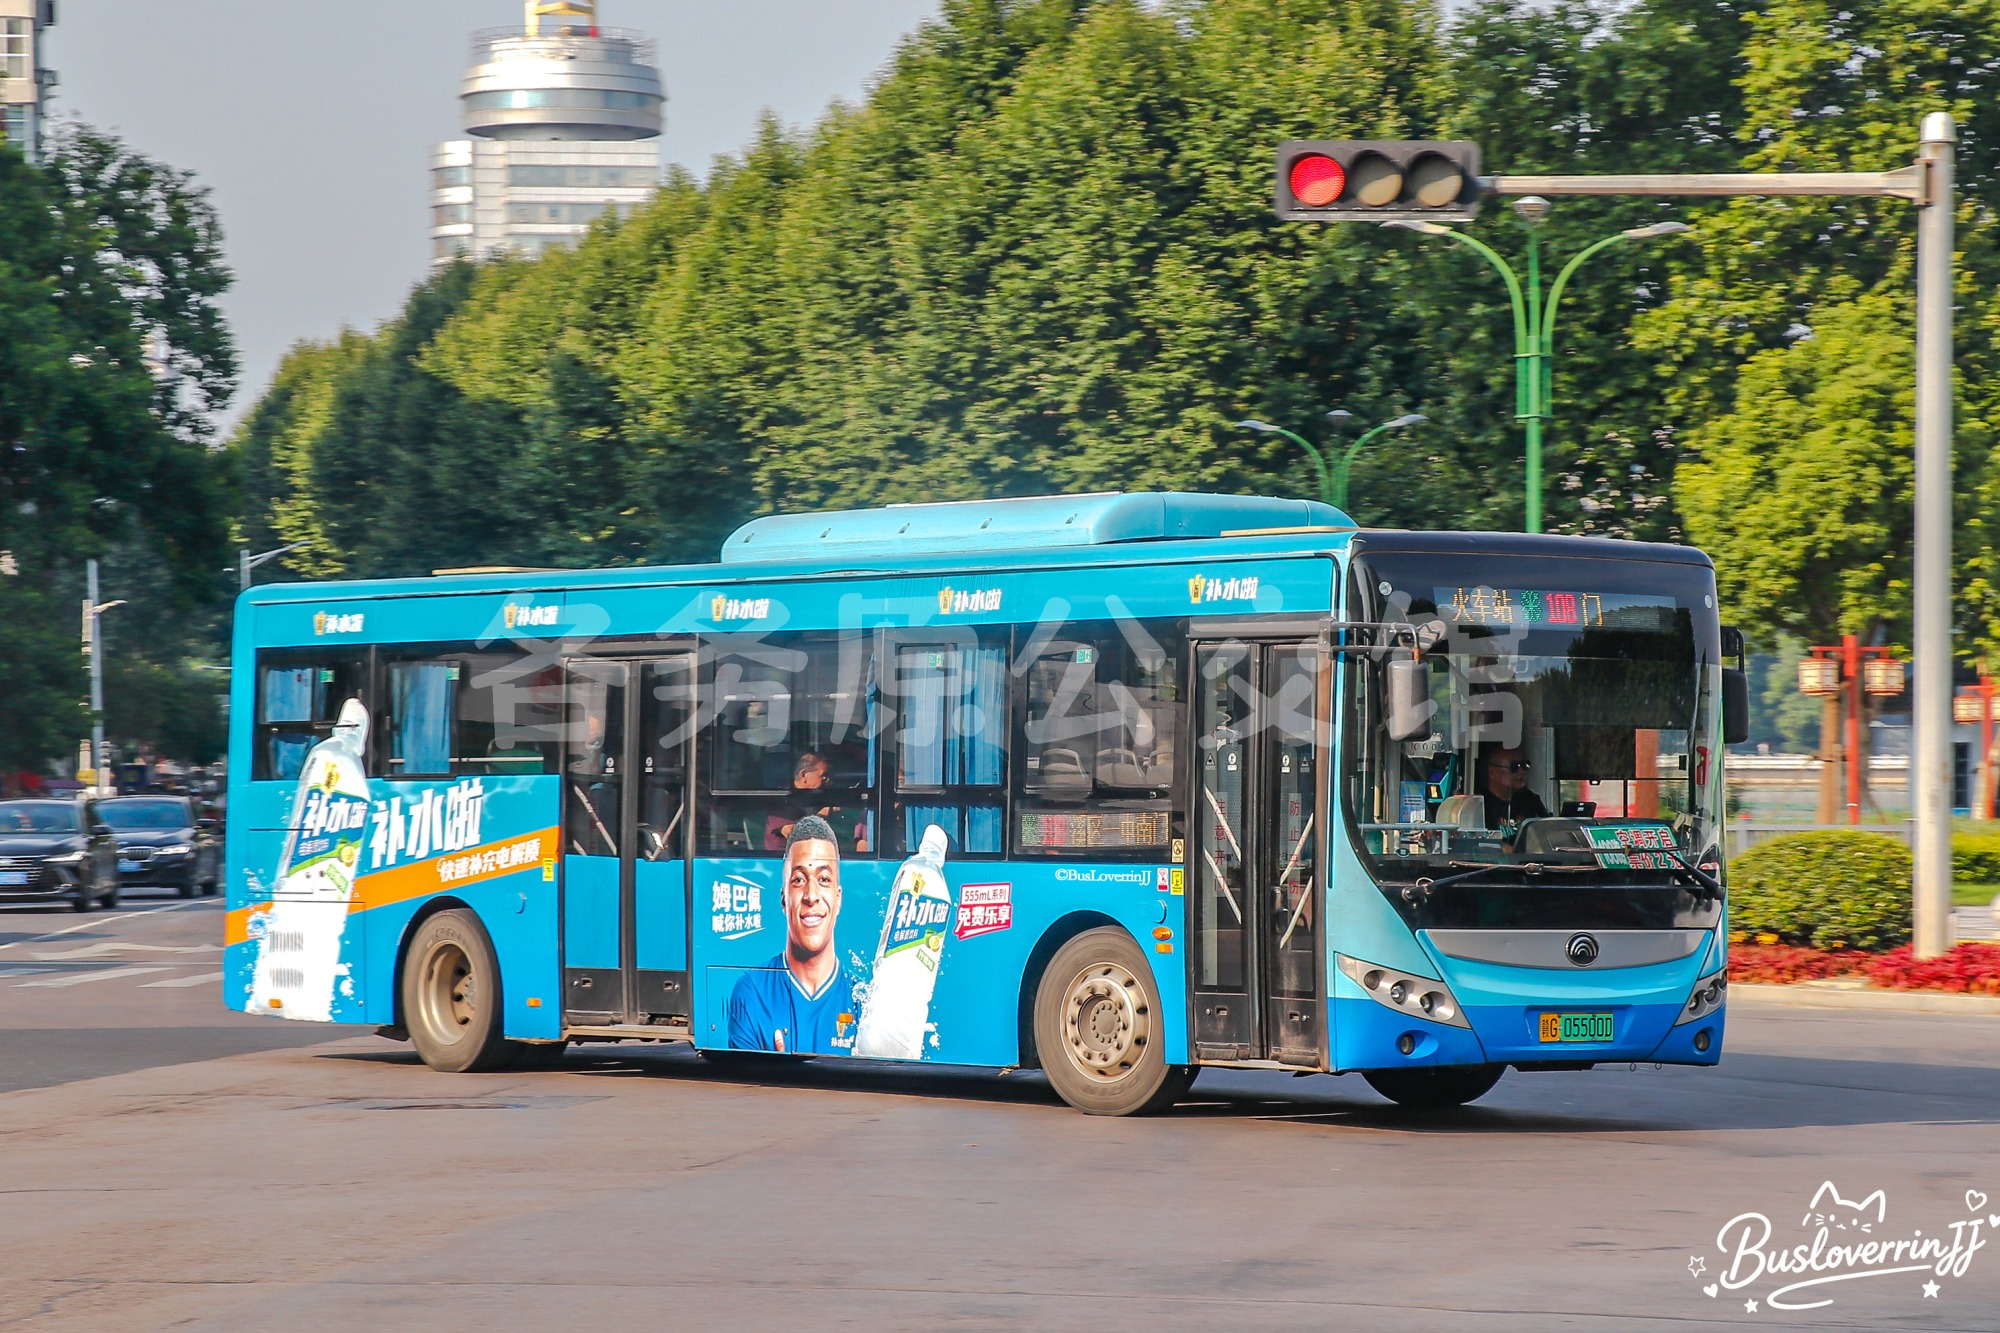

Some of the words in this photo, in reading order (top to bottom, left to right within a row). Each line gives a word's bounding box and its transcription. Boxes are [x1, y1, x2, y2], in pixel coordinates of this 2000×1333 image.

[954, 588, 1002, 612] 补水啦
[1205, 576, 1258, 602] 补水啦
[1452, 587, 1513, 623] 火车站
[301, 792, 367, 838] 补水啦
[368, 777, 484, 869] 补水啦
[1615, 829, 1676, 848] 空调开启
[440, 838, 541, 883] 快速补充电解质
[896, 894, 949, 929] 补水啦
[954, 905, 1011, 933] 免费乐享
